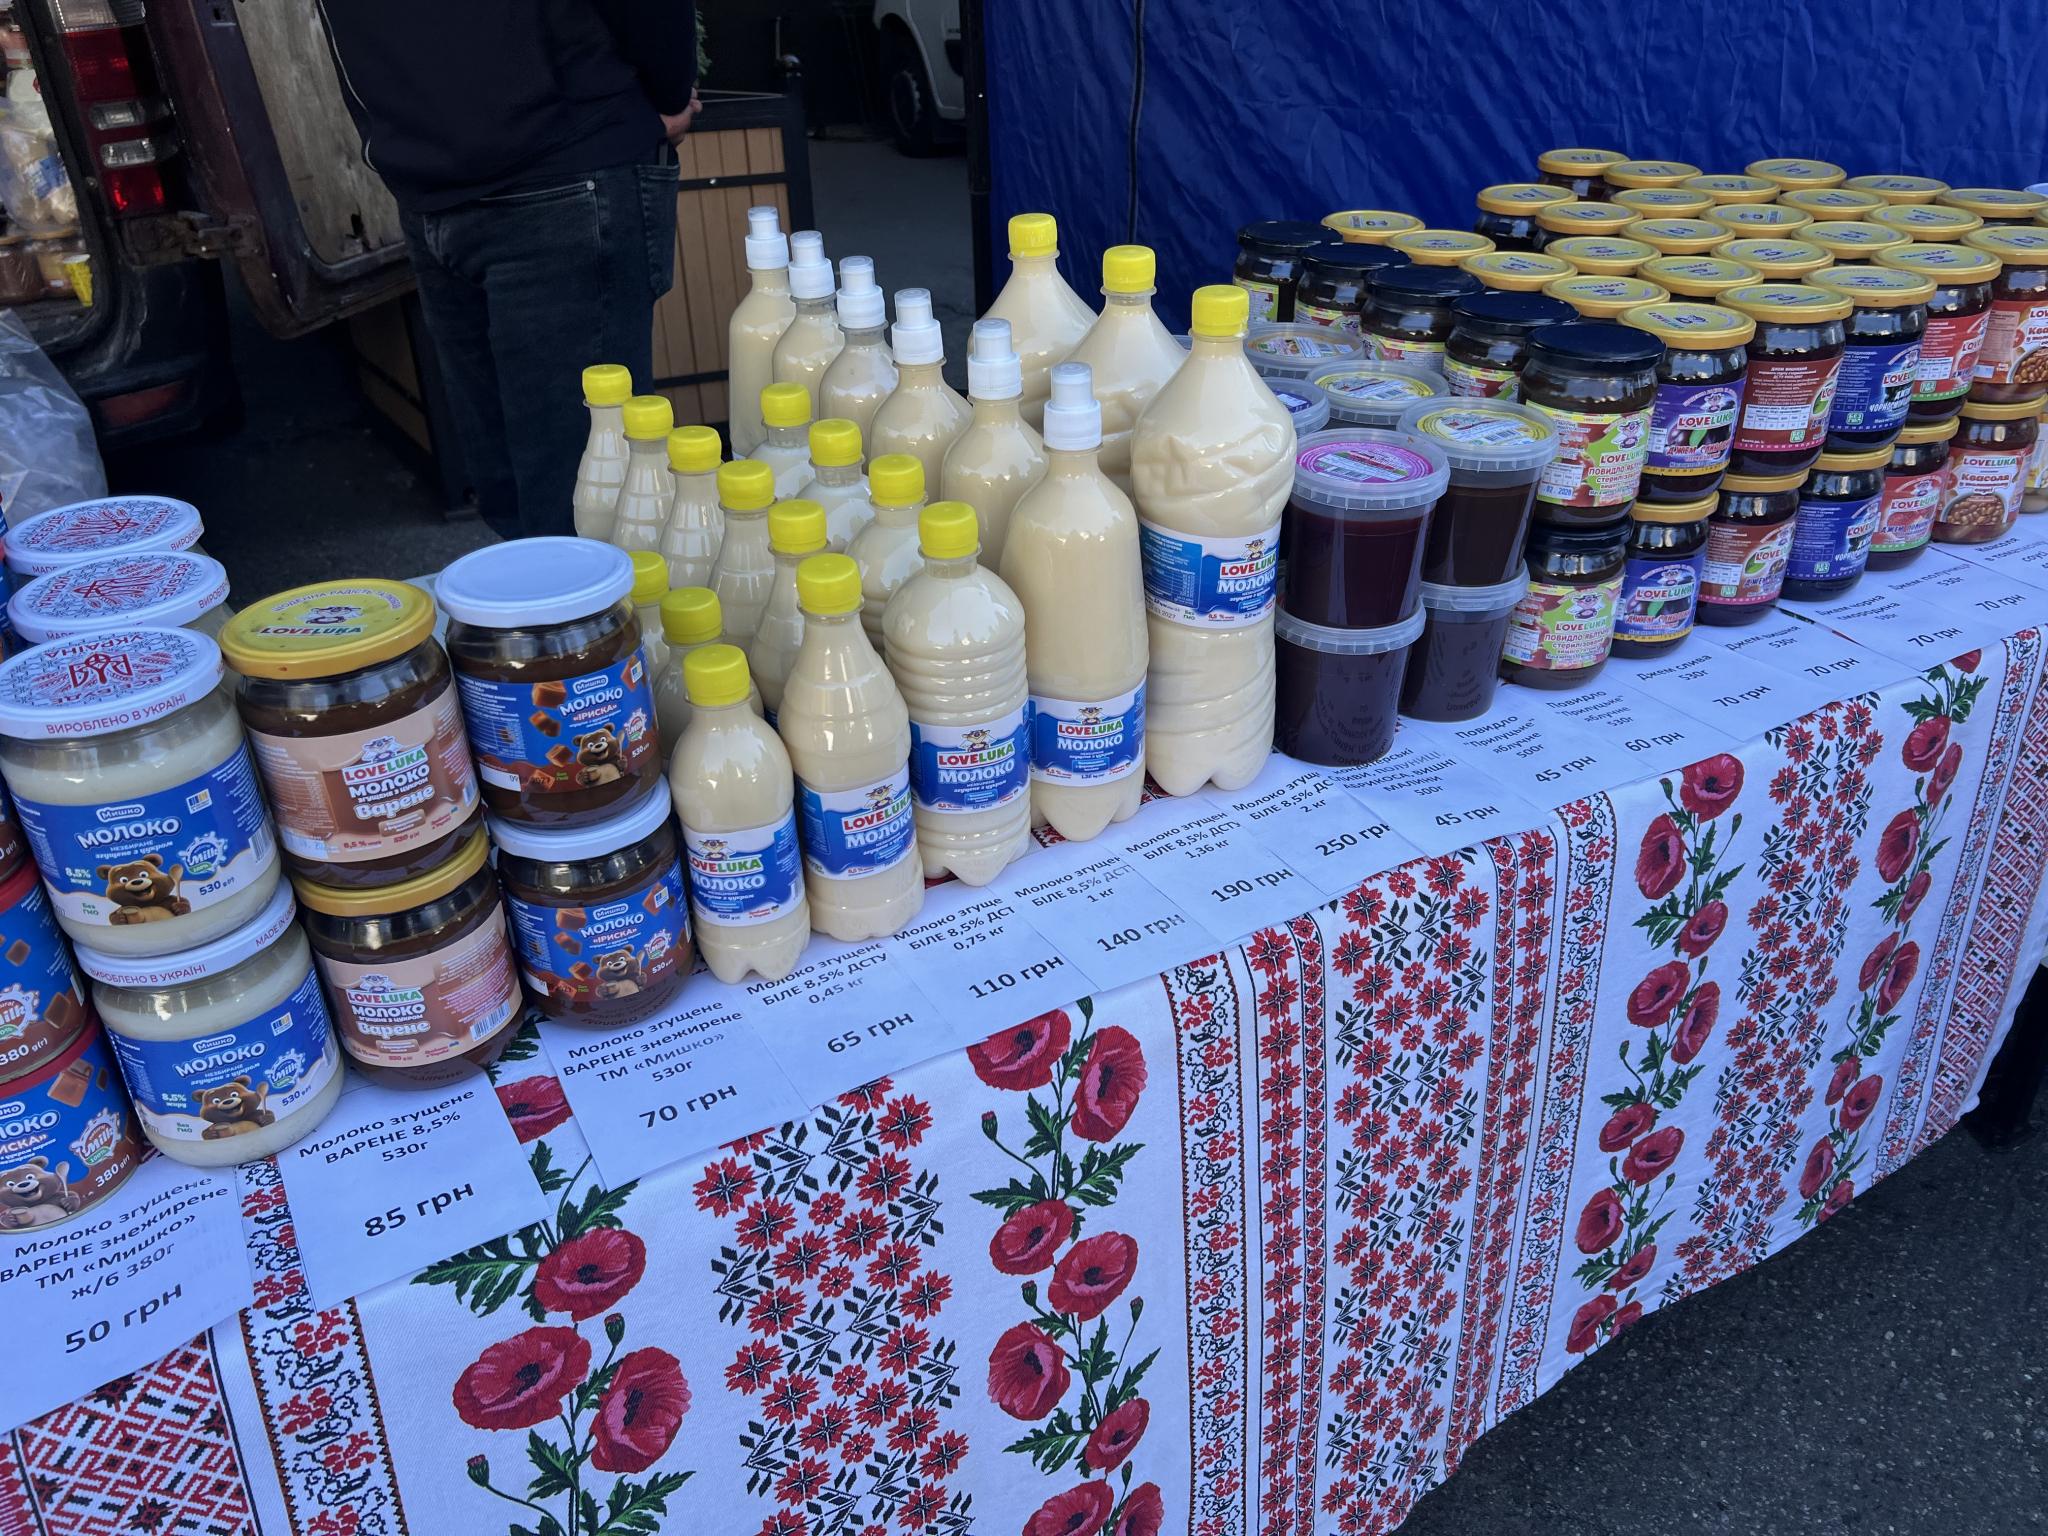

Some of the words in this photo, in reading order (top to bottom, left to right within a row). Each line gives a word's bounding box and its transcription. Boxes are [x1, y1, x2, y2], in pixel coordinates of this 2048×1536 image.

[1221, 552, 1276, 577] LOVELUKA
[1217, 567, 1276, 594] МОЛОКО
[1975, 599, 2000, 611] 70
[1998, 594, 2027, 606] грн
[260, 626, 362, 636] LOVELUKA
[1724, 635, 1763, 652] Джем
[1908, 633, 1935, 647] 70
[1932, 626, 1964, 640] грн
[44, 632, 146, 658] УКРАЇНА
[1636, 663, 1677, 681] Джем
[1676, 654, 1713, 671] слива
[1678, 669, 1710, 681] 530г
[1804, 665, 1831, 677] 70
[1828, 656, 1862, 671] грн
[559, 687, 624, 717] МОЛОКО
[1545, 690, 1608, 709] Повидло
[1712, 695, 1739, 708] 70
[1738, 685, 1772, 701] грн
[46, 713, 130, 735] ВИРОБЛЕНО
[131, 710, 142, 721] В
[143, 693, 187, 718] УКРАЇНІ
[572, 704, 618, 723] «ІРИСКА»
[1583, 706, 1632, 723] яблучне
[1058, 720, 1123, 736] LOVELUKA
[1455, 715, 1519, 739] Повидло
[938, 742, 1015, 766] LOVELUKA
[1056, 733, 1123, 751] МОЛОКО
[1492, 731, 1542, 755] яблучне
[1516, 744, 1545, 759] 500г
[1624, 738, 1652, 753] 60
[1651, 731, 1686, 748] грн
[344, 749, 426, 782] LOVELUKA
[938, 758, 1015, 784] МОЛОКО
[1412, 758, 1457, 776] ВИШНІ
[1535, 768, 1562, 783] 45
[1561, 755, 1597, 773] грн
[349, 764, 430, 798] МОЛОКО
[1383, 775, 1443, 793] МАЛИНИ
[1414, 784, 1446, 797] 500г
[843, 791, 912, 832] LOVELUKA
[1232, 787, 1286, 813] Молоко
[1249, 804, 1283, 821] БІЛЕ
[1280, 789, 1315, 808] 8,5%
[1299, 805, 1313, 814] 2
[1312, 798, 1328, 810] кг
[101, 807, 141, 821] Мишко
[1435, 813, 1462, 828] 45
[1462, 804, 1501, 820] грн
[76, 817, 181, 850] МОЛОКО
[845, 807, 913, 850] МОЛОКО
[1125, 826, 1181, 854] Молоко
[1143, 841, 1176, 861] БІЛЕ
[1175, 830, 1210, 849] 8,5%
[1184, 843, 1216, 861] 1,36
[1217, 838, 1231, 850] кг
[1314, 833, 1359, 857] 250
[199, 880, 222, 896] 530
[1014, 872, 1075, 899] Молоко
[1031, 889, 1068, 908] БІЛЕ
[1068, 875, 1103, 896] 8,5%
[1086, 894, 1100, 904] 1
[1099, 886, 1115, 899] кг
[1211, 878, 1255, 904] 190
[1254, 867, 1295, 888] грн
[255, 927, 281, 948] MADE
[579, 913, 645, 939] МОЛОКО
[592, 928, 638, 944] «ІРИСКА»
[893, 914, 957, 942] Молоко
[908, 931, 948, 952] БІЛЕ
[947, 916, 986, 938] 8,5%
[953, 931, 987, 952] 0,75
[989, 925, 1006, 938] кг
[1097, 927, 1142, 953] 140
[1143, 912, 1187, 935] грн
[149, 974, 159, 984] В
[160, 963, 207, 983] УКРАЇНІ
[746, 964, 815, 996] Молоко
[762, 985, 803, 1007] БІЛЕ
[803, 967, 845, 991] 8,5%
[846, 951, 889, 976] ДСТУ
[968, 972, 1017, 1000] 110
[1020, 955, 1065, 980] грн
[348, 989, 423, 1004] LOVELUKA
[808, 983, 845, 1006] 0,45
[847, 976, 865, 989] кг
[352, 1003, 426, 1019] МОЛОКО
[198, 1035, 234, 1051] Мишко
[567, 1028, 645, 1060] Молоко
[649, 1001, 725, 1034] згущене
[827, 1030, 863, 1054] 65
[866, 1012, 915, 1039] грн
[562, 1045, 638, 1078] ВАРЕНЕ
[641, 1010, 745, 1054] знежирене
[174, 1042, 266, 1078] МОЛОКО
[596, 1065, 630, 1083] ТМ
[634, 1032, 726, 1072] «Мишко»
[652, 1058, 694, 1083] 530г
[282, 1091, 300, 1107] 530
[638, 1105, 680, 1130] 70
[685, 1084, 739, 1114] грн
[298, 1120, 386, 1158] Молоко
[390, 1090, 476, 1127] згущене
[83, 1128, 114, 1157] Milk
[324, 1130, 408, 1164] ВАРЕНЕ
[412, 1111, 462, 1137] 8,5%
[381, 1140, 431, 1163] 530г
[95, 1163, 119, 1188] 380
[14, 1219, 113, 1258] Молоко
[118, 1177, 214, 1224] згущене
[363, 1207, 407, 1238] 85
[416, 1182, 475, 1217] грн
[0, 1242, 94, 1284] ВАРЕНЕ
[100, 1186, 230, 1250] знежирене
[35, 1267, 75, 1290] ТМ
[82, 1214, 197, 1274] «Мишко»
[71, 1274, 121, 1300] ж/б
[126, 1242, 176, 1279] 380г
[65, 1320, 111, 1355] 50
[123, 1283, 183, 1328] грн
